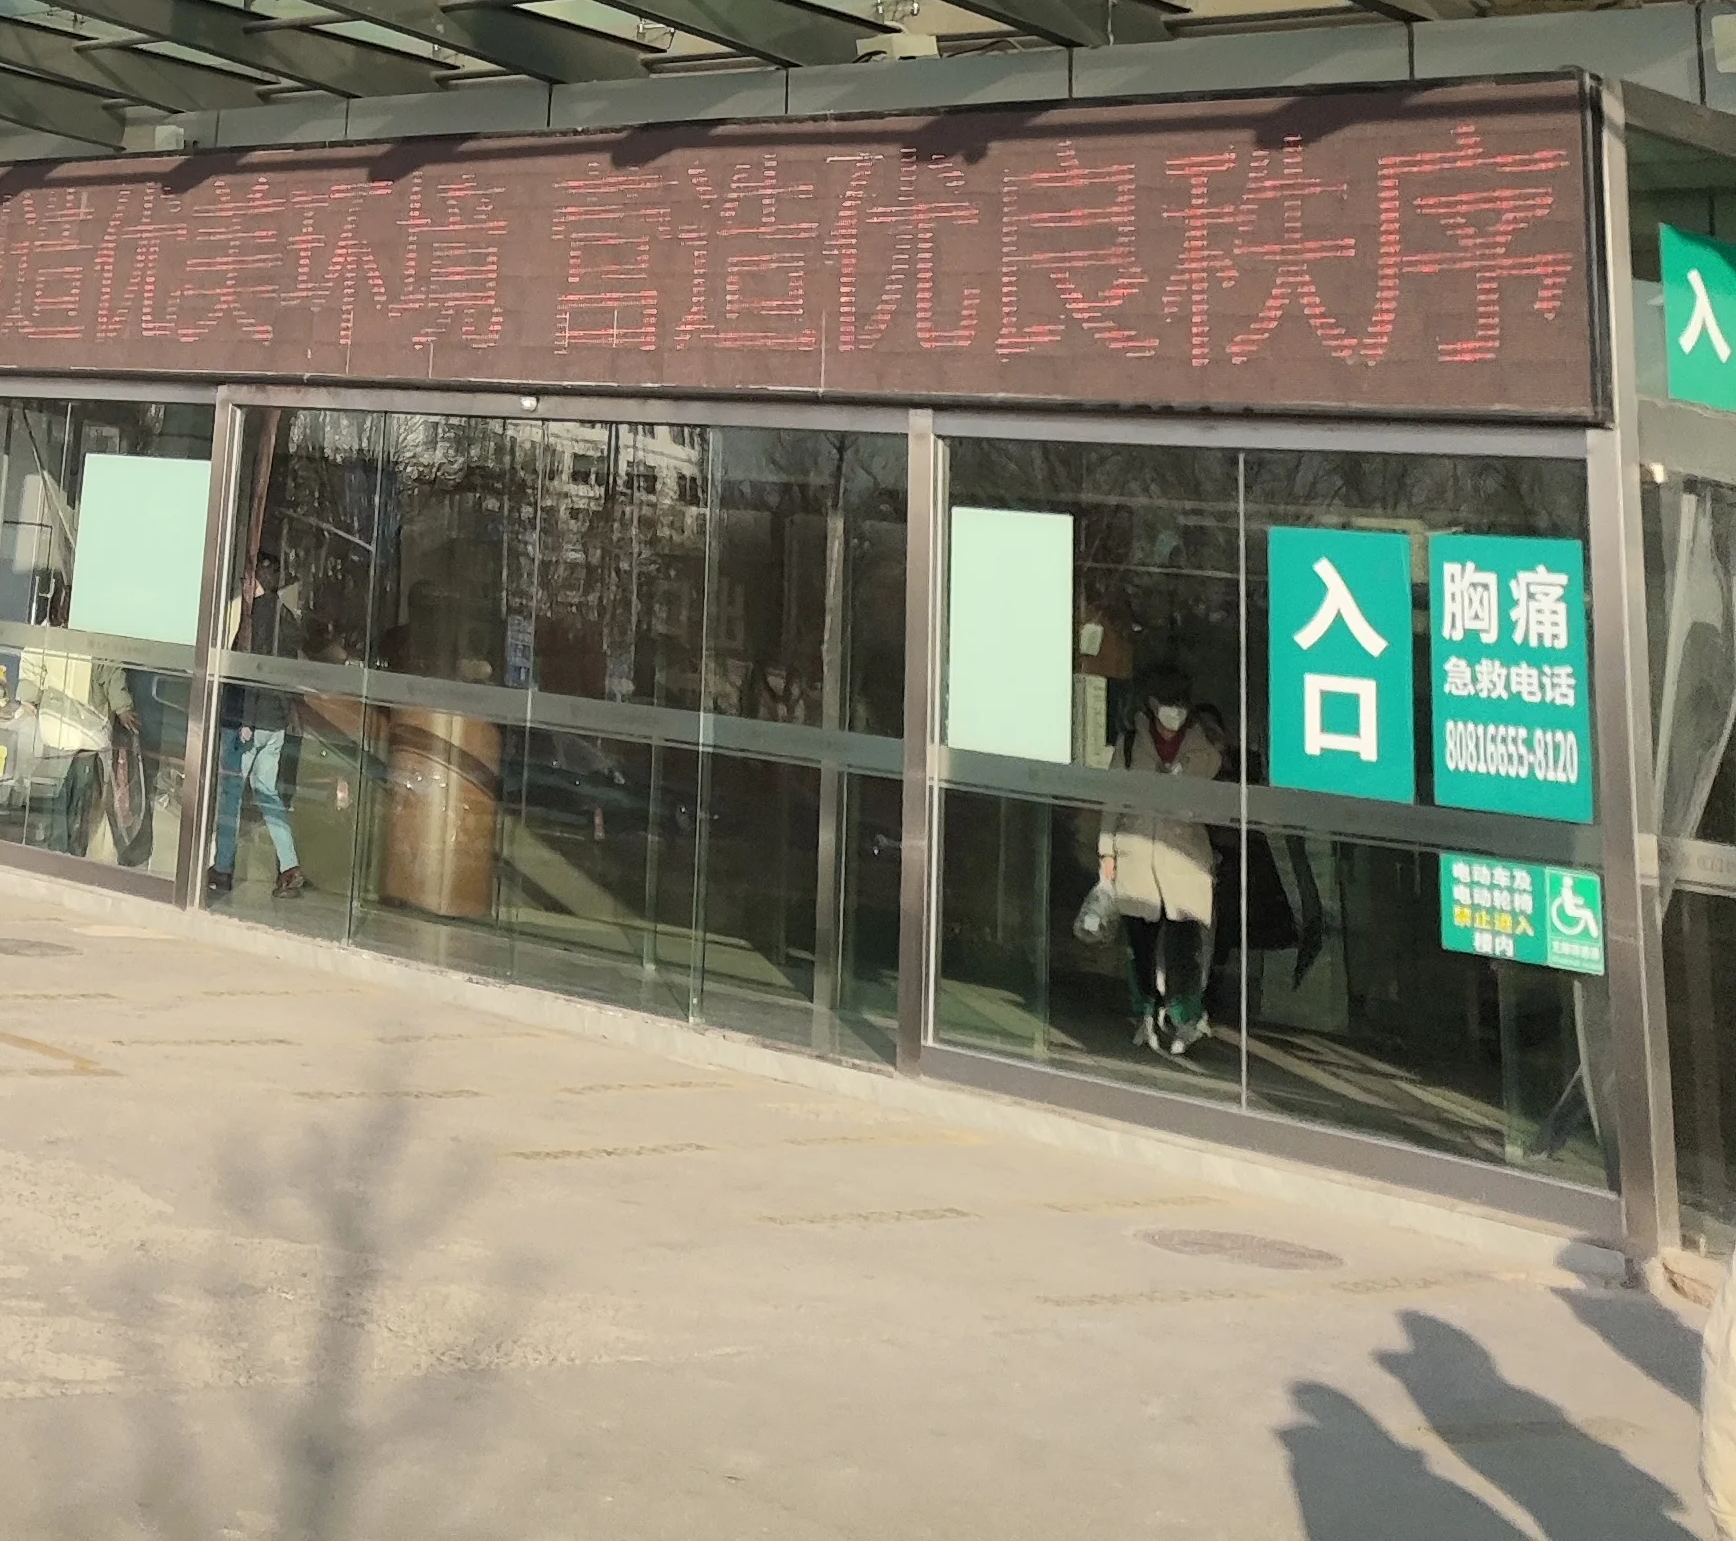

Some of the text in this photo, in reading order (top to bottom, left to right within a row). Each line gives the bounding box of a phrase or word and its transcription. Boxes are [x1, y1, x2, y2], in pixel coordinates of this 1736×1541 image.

[553, 123, 1573, 366] 营造优良秩序
[1678, 268, 1732, 364] 入
[1442, 560, 1570, 649] 胸痛
[1292, 556, 1389, 763] 入口
[1443, 656, 1576, 708] 急救电话
[1446, 719, 1578, 784] 80816655-8120
